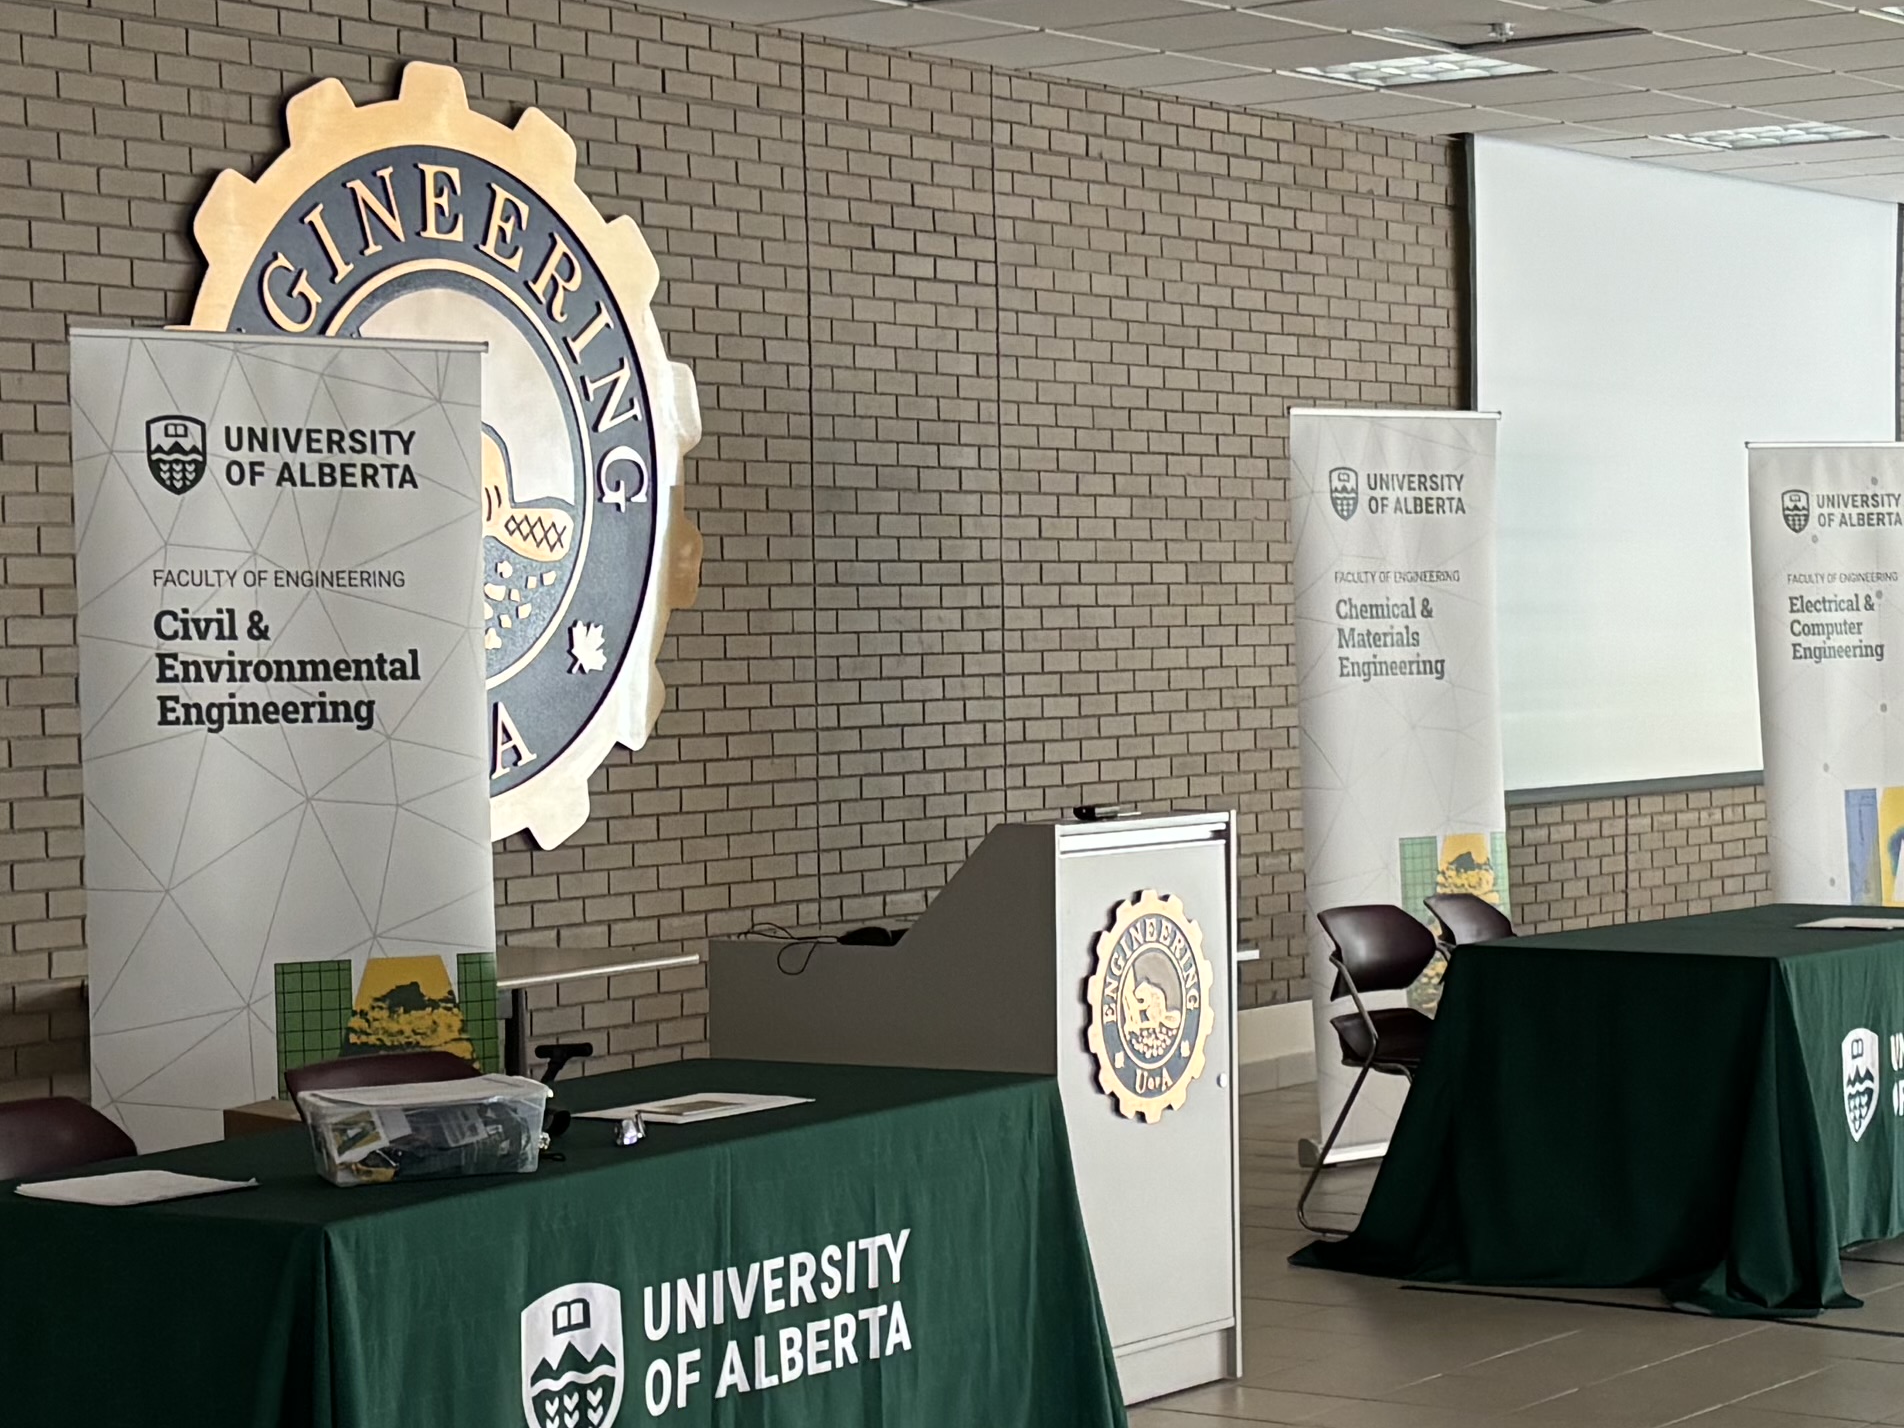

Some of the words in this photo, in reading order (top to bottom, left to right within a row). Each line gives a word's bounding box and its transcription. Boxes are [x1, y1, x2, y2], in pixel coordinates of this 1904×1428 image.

[256, 160, 651, 514] GINEERING
[224, 425, 416, 455] UNIVERSITY
[225, 460, 265, 487] OF
[275, 461, 419, 490] ALBERTA
[1367, 473, 1464, 492] UNIVERSITY
[1368, 496, 1389, 514] OF
[1394, 497, 1466, 515] ALBERTA
[1816, 493, 1901, 508] UNIVERSITY
[1818, 513, 1835, 527] OF
[1839, 512, 1902, 527] ALBERTA
[153, 569, 236, 588] FACULTY
[243, 569, 268, 588] OF
[274, 570, 405, 588] ENGINEERING
[1334, 571, 1376, 583] FACULTY
[1379, 571, 1391, 583] OF
[1394, 570, 1460, 583] ENGINEERING
[1336, 596, 1417, 620] Chemical
[1421, 597, 1434, 618] &
[1789, 593, 1860, 613] Electrical
[1864, 594, 1875, 611] &
[153, 607, 238, 641] Civil
[246, 609, 271, 641] &
[1790, 619, 1863, 640] Computer
[1337, 625, 1420, 649] Materials
[1792, 639, 1885, 664] Engineering
[155, 648, 421, 684] Environmental
[1338, 652, 1445, 682] Engineering
[157, 690, 375, 734] Engineering
[1103, 918, 1199, 1024] ENGINEERING
[643, 1228, 911, 1342] UNIVERSITY
[645, 1348, 701, 1417] OF
[714, 1300, 912, 1399] ALBERTA
